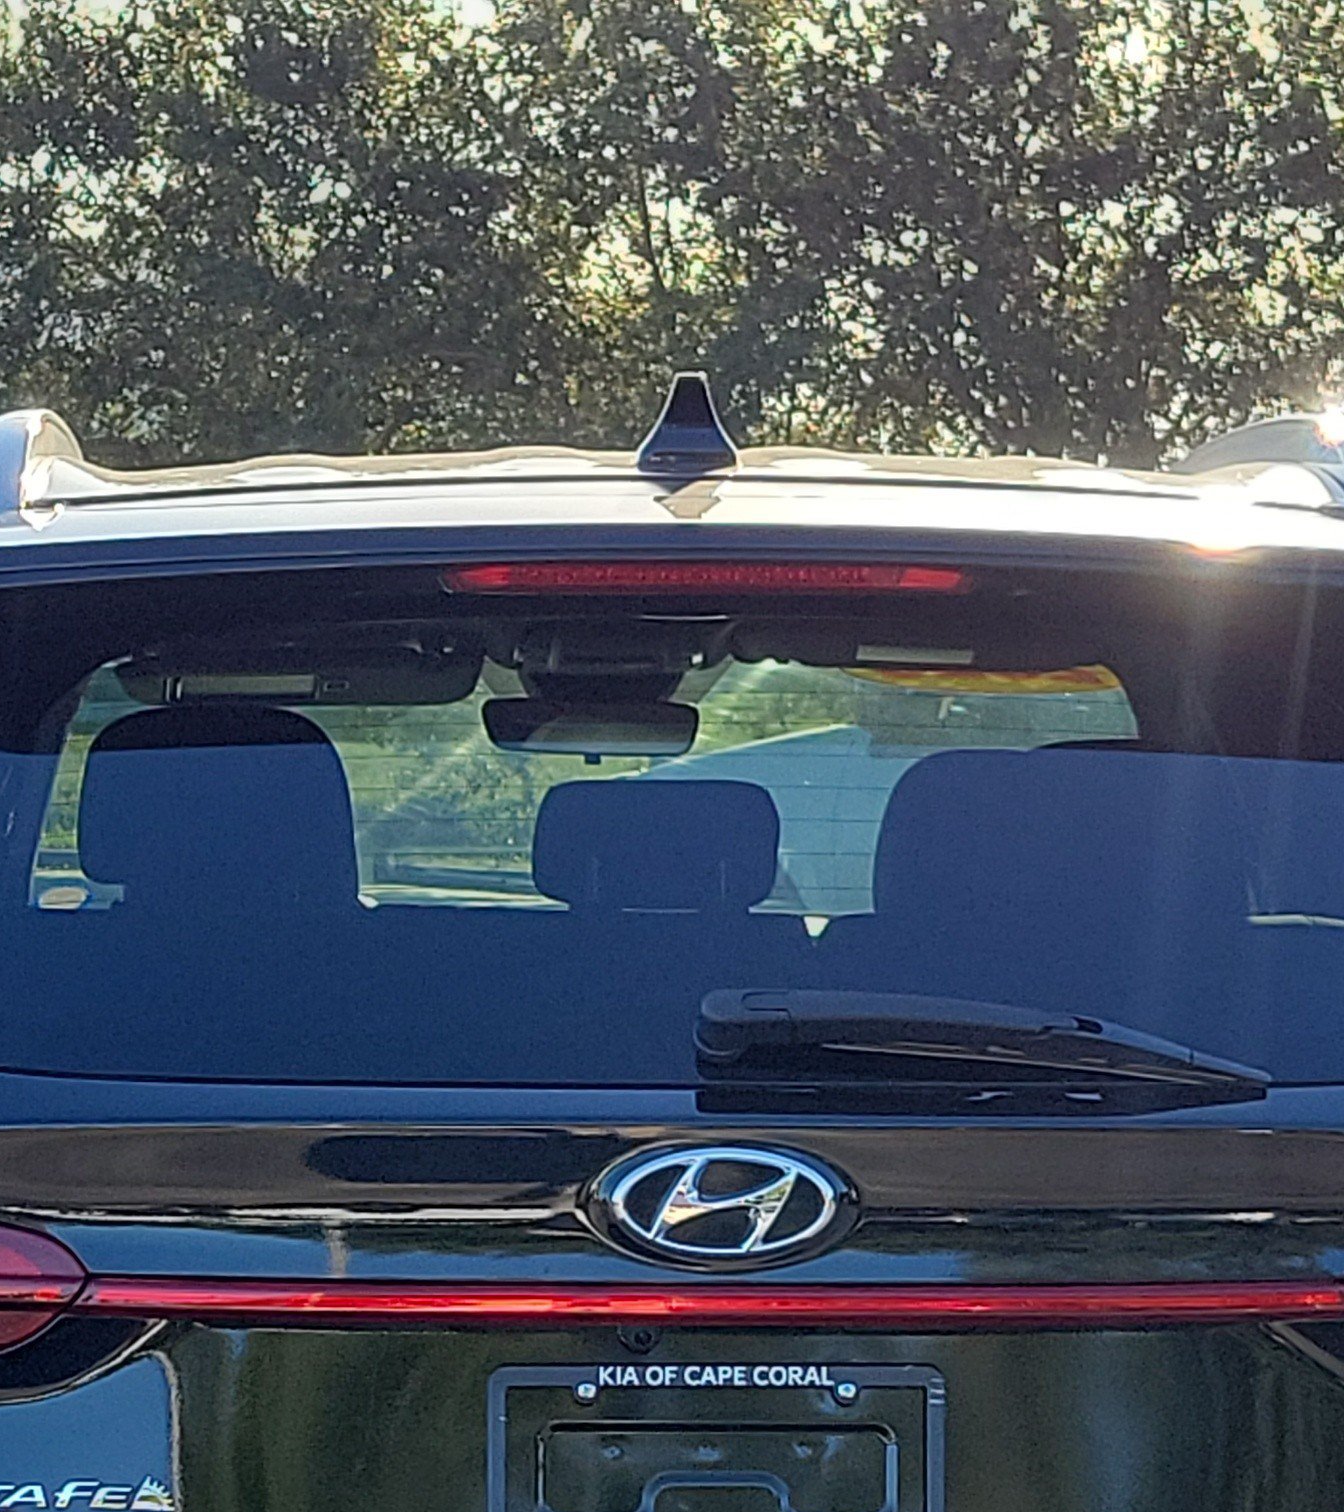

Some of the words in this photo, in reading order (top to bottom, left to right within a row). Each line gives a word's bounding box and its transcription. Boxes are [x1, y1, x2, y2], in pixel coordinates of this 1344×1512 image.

[599, 1366, 639, 1386] KIA
[646, 1366, 678, 1386] OF
[684, 1366, 746, 1386] CAPE
[754, 1366, 834, 1386] CORAL
